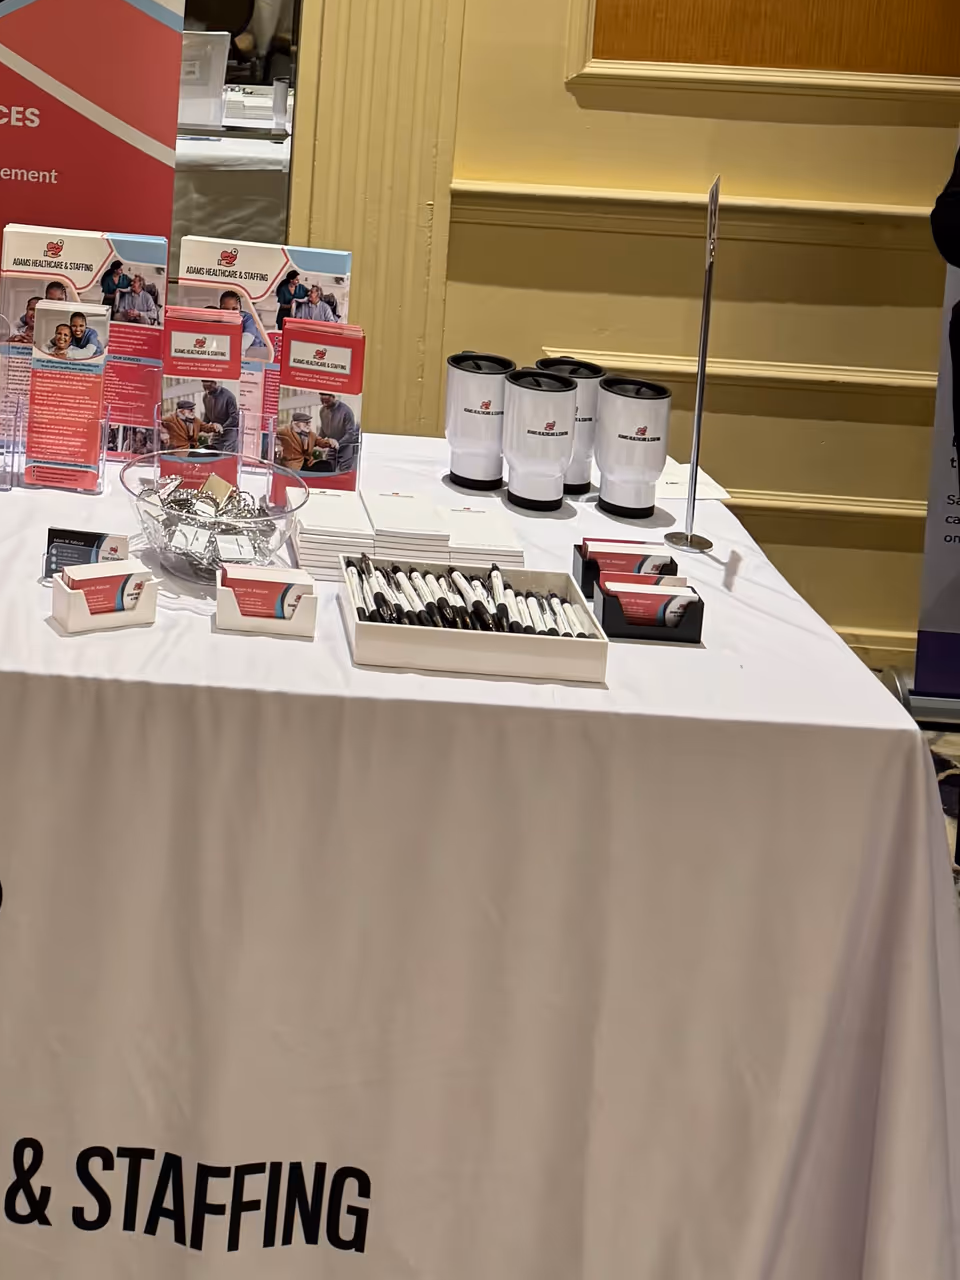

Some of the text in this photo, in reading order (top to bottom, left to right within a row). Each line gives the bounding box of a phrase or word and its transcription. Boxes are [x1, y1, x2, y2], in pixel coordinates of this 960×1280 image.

[12, 258, 94, 272] ADAMS HEALTHCARE & STAFFING
[186, 266, 269, 282] ADAMS HEALTHCARE & STAFFING
[305, 359, 326, 367] HEALTHCARE
[3, 1137, 53, 1226] &
[71, 1145, 372, 1253] STAFFING
